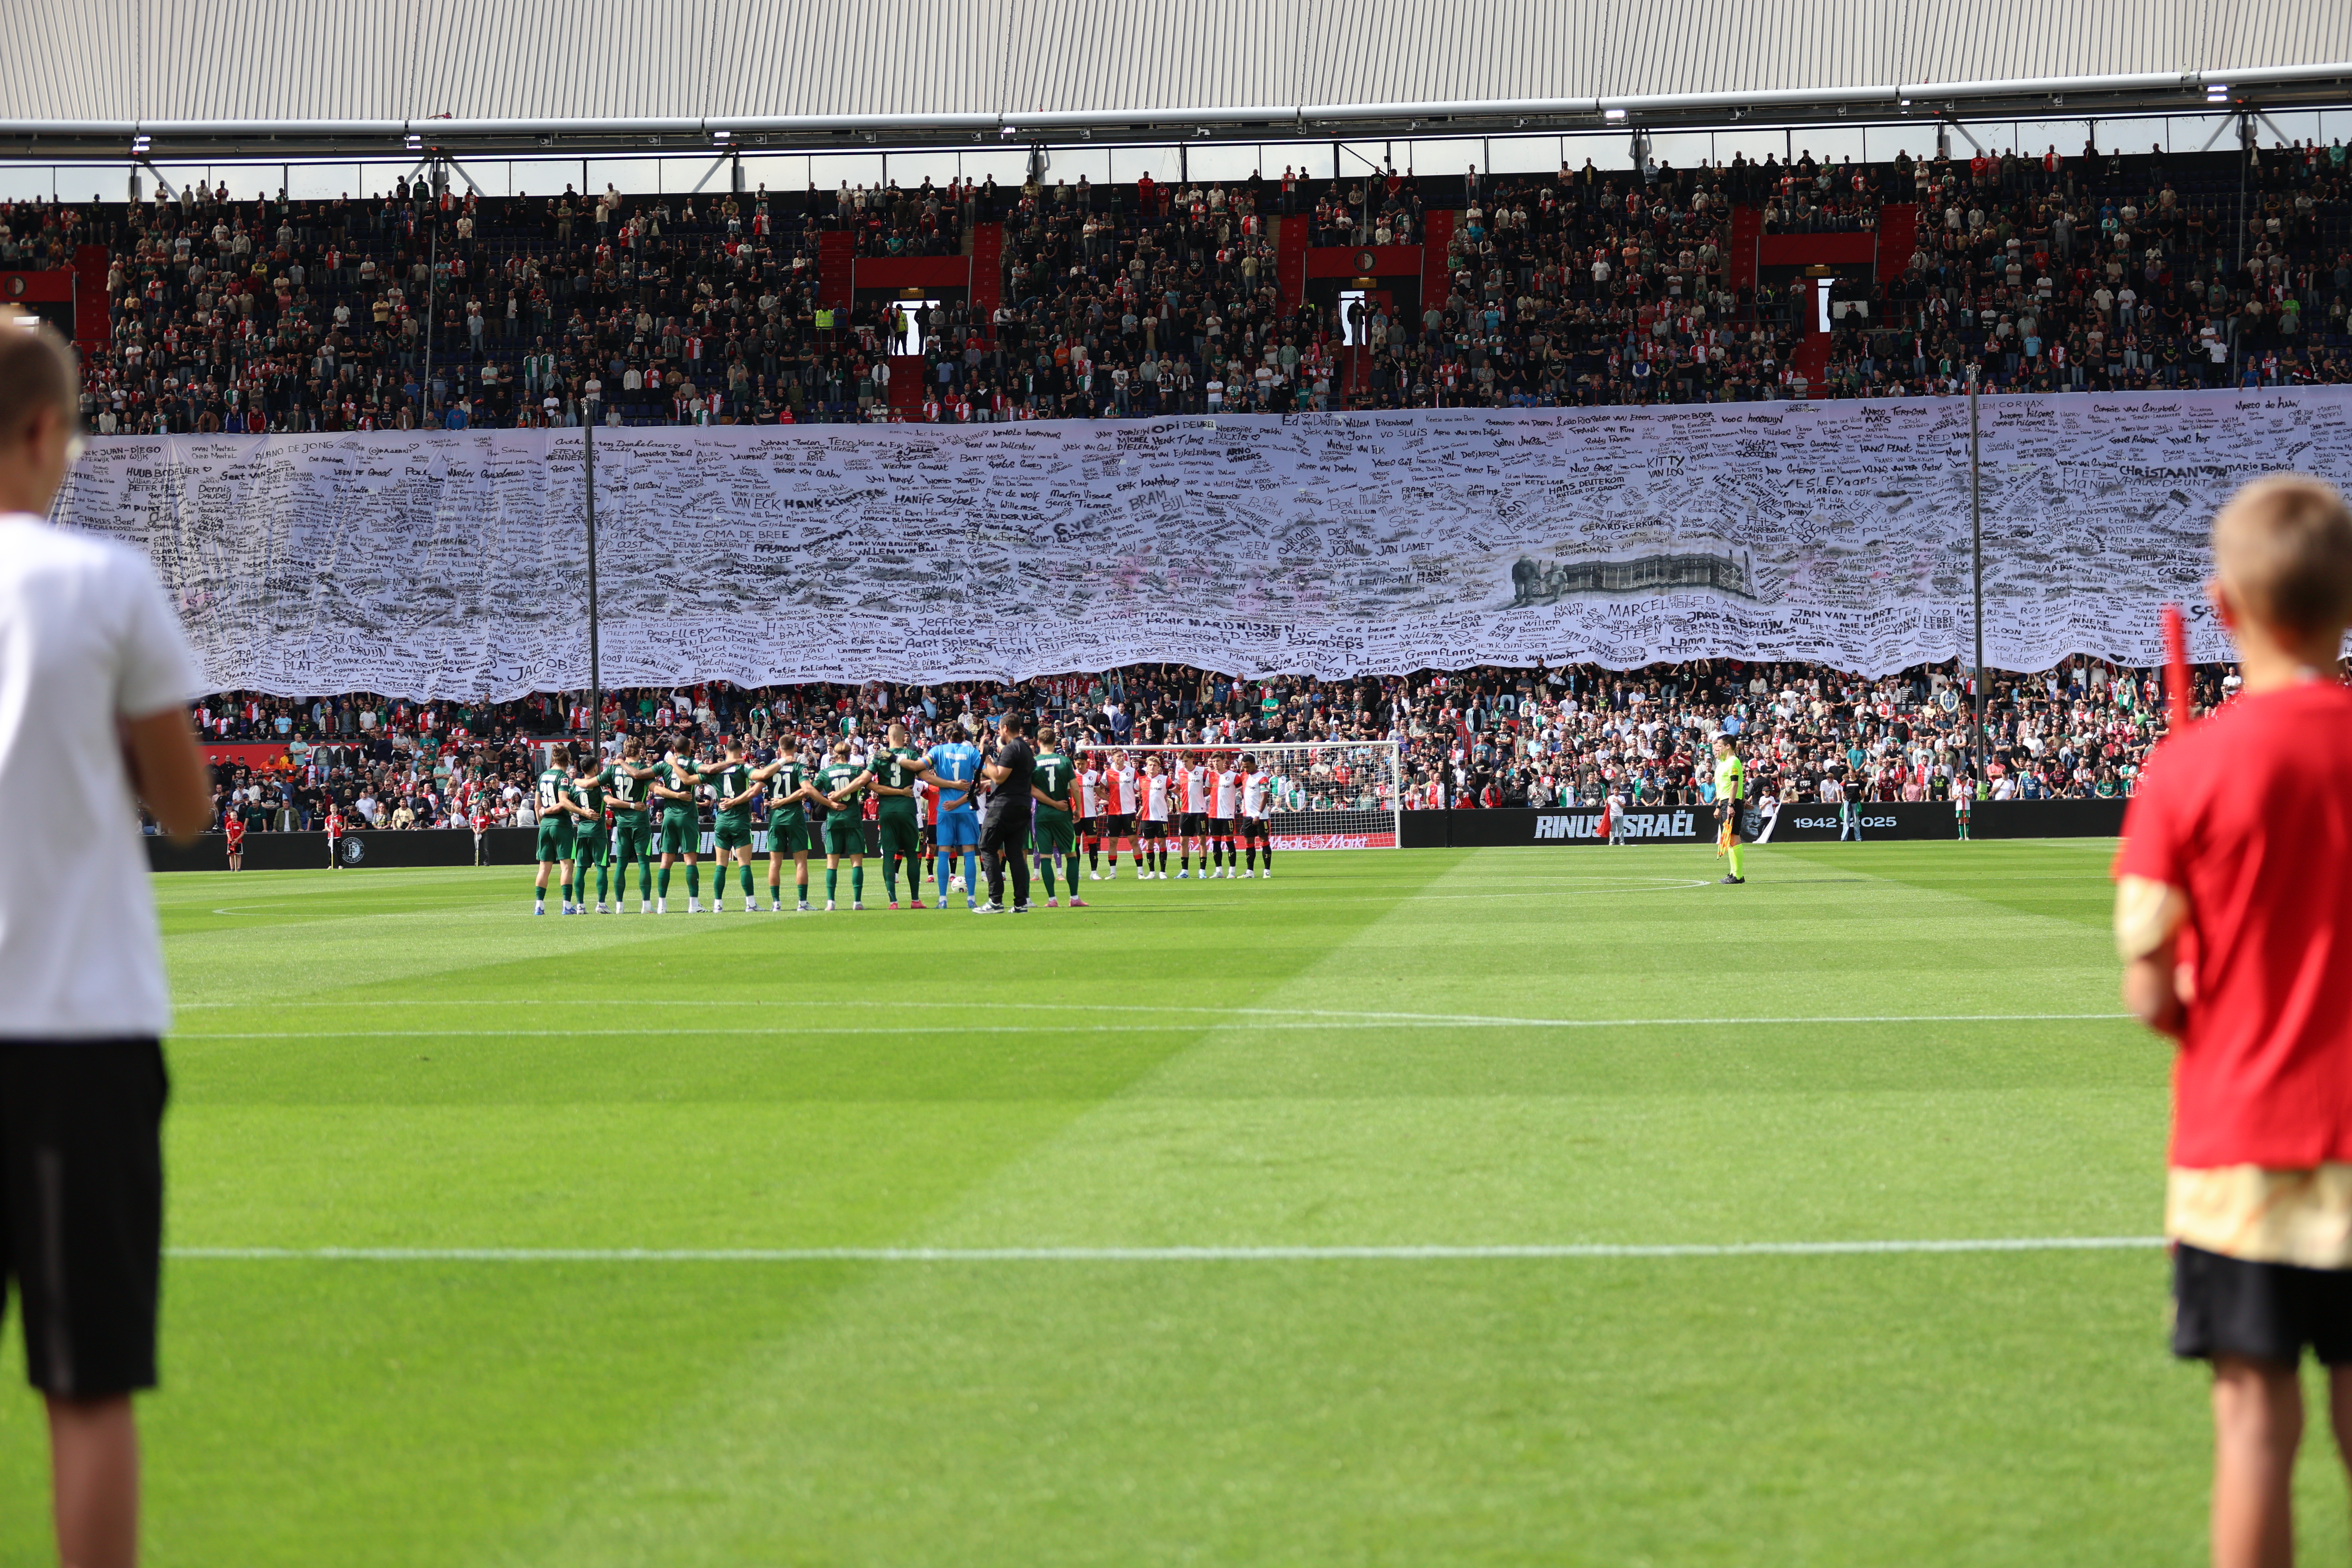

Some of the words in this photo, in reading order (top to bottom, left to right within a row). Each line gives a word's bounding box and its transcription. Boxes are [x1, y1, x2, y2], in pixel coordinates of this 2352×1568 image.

[1999, 400, 2043, 408] CORNAX
[302, 441, 334, 453] JONG
[127, 468, 152, 478] HUUB
[1259, 483, 1280, 491] BOOM
[732, 497, 751, 508] VAN
[755, 499, 780, 510] ECK
[1129, 490, 1167, 511] BRAM
[78, 516, 111, 524] CHARLES
[704, 530, 735, 539] OMA
[1376, 546, 1397, 556] JAN
[723, 553, 748, 562] HANS
[557, 568, 587, 578] KEES
[1608, 599, 1669, 618] MARCEL
[325, 634, 361, 645] RUUD
[1610, 626, 1661, 644] STEEN
[946, 752, 967, 760] WOLFSBURG
[1037, 758, 1060, 766] WOLFSBURG
[829, 769, 851, 777] WOLFSBURG
[891, 762, 901, 787] 3
[952, 762, 960, 781] 1
[1045, 766, 1056, 792] 7
[614, 776, 633, 801] 32
[724, 775, 735, 799] 4
[773, 773, 791, 798] 21
[540, 782, 555, 807] 39
[1162, 824, 1167, 832] 14
[1200, 820, 1205, 829] 16
[1228, 820, 1234, 828] 15
[1263, 821, 1268, 829] 8
[1613, 810, 1696, 837] SRAËL
[1793, 818, 1837, 828] 1942
[1324, 834, 1368, 849] Markt
